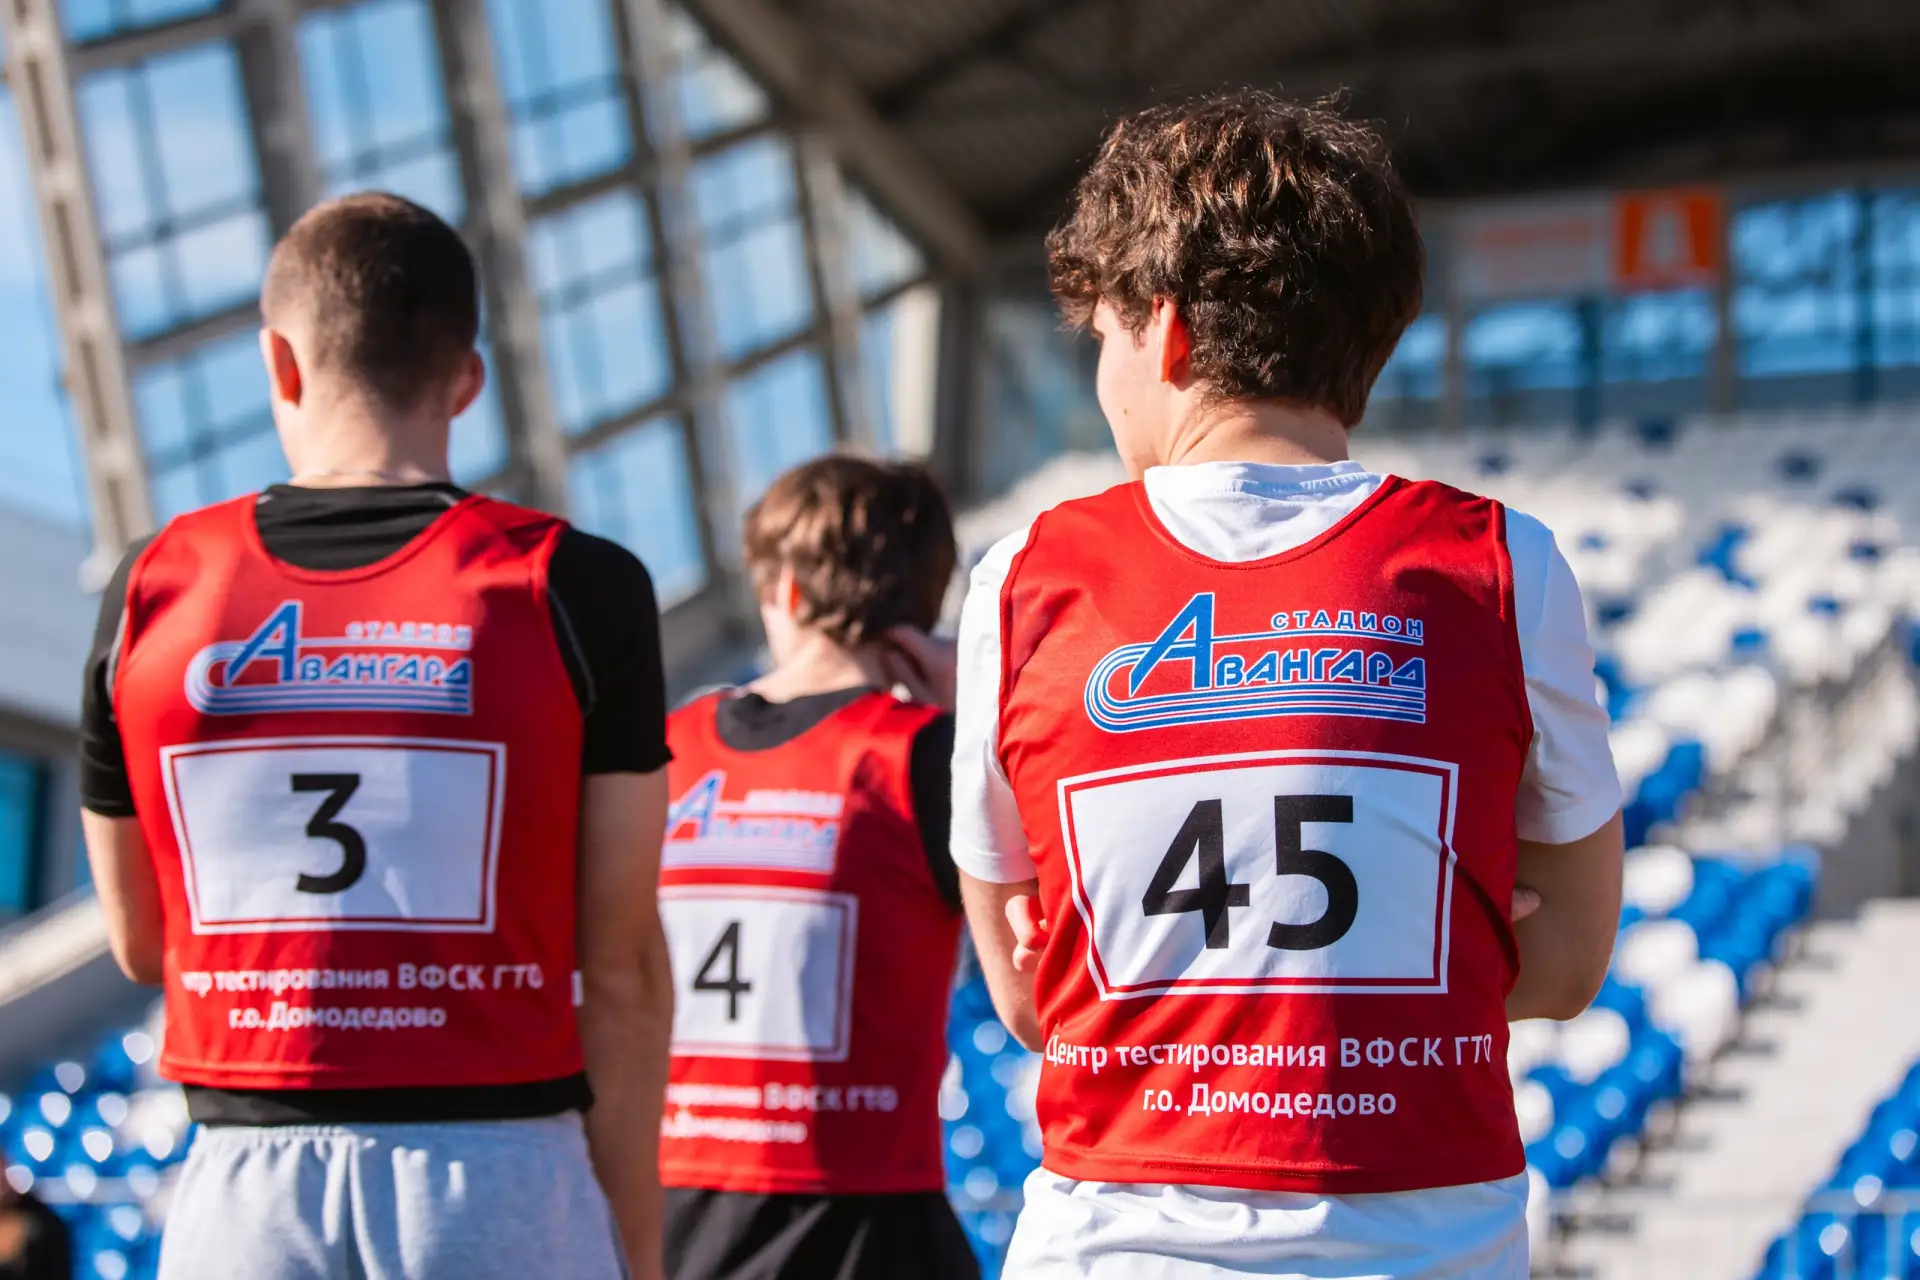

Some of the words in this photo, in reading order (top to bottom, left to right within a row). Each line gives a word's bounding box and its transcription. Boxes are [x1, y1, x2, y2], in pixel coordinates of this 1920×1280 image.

[1271, 610, 1424, 637] СТАДИОН
[290, 773, 367, 894] 3
[1142, 794, 1359, 951] 45
[397, 963, 486, 990] ВФСК
[492, 963, 544, 990] ГТО
[691, 919, 752, 1022] 4
[228, 1007, 266, 1029] г.о.
[266, 1001, 447, 1031] Домодедово
[1045, 1034, 1107, 1074] Центр
[1115, 1043, 1326, 1073] тестирования
[1340, 1037, 1445, 1068] ВФСК
[1143, 1088, 1182, 1112] г.о.
[1187, 1083, 1397, 1118] Домодедово
